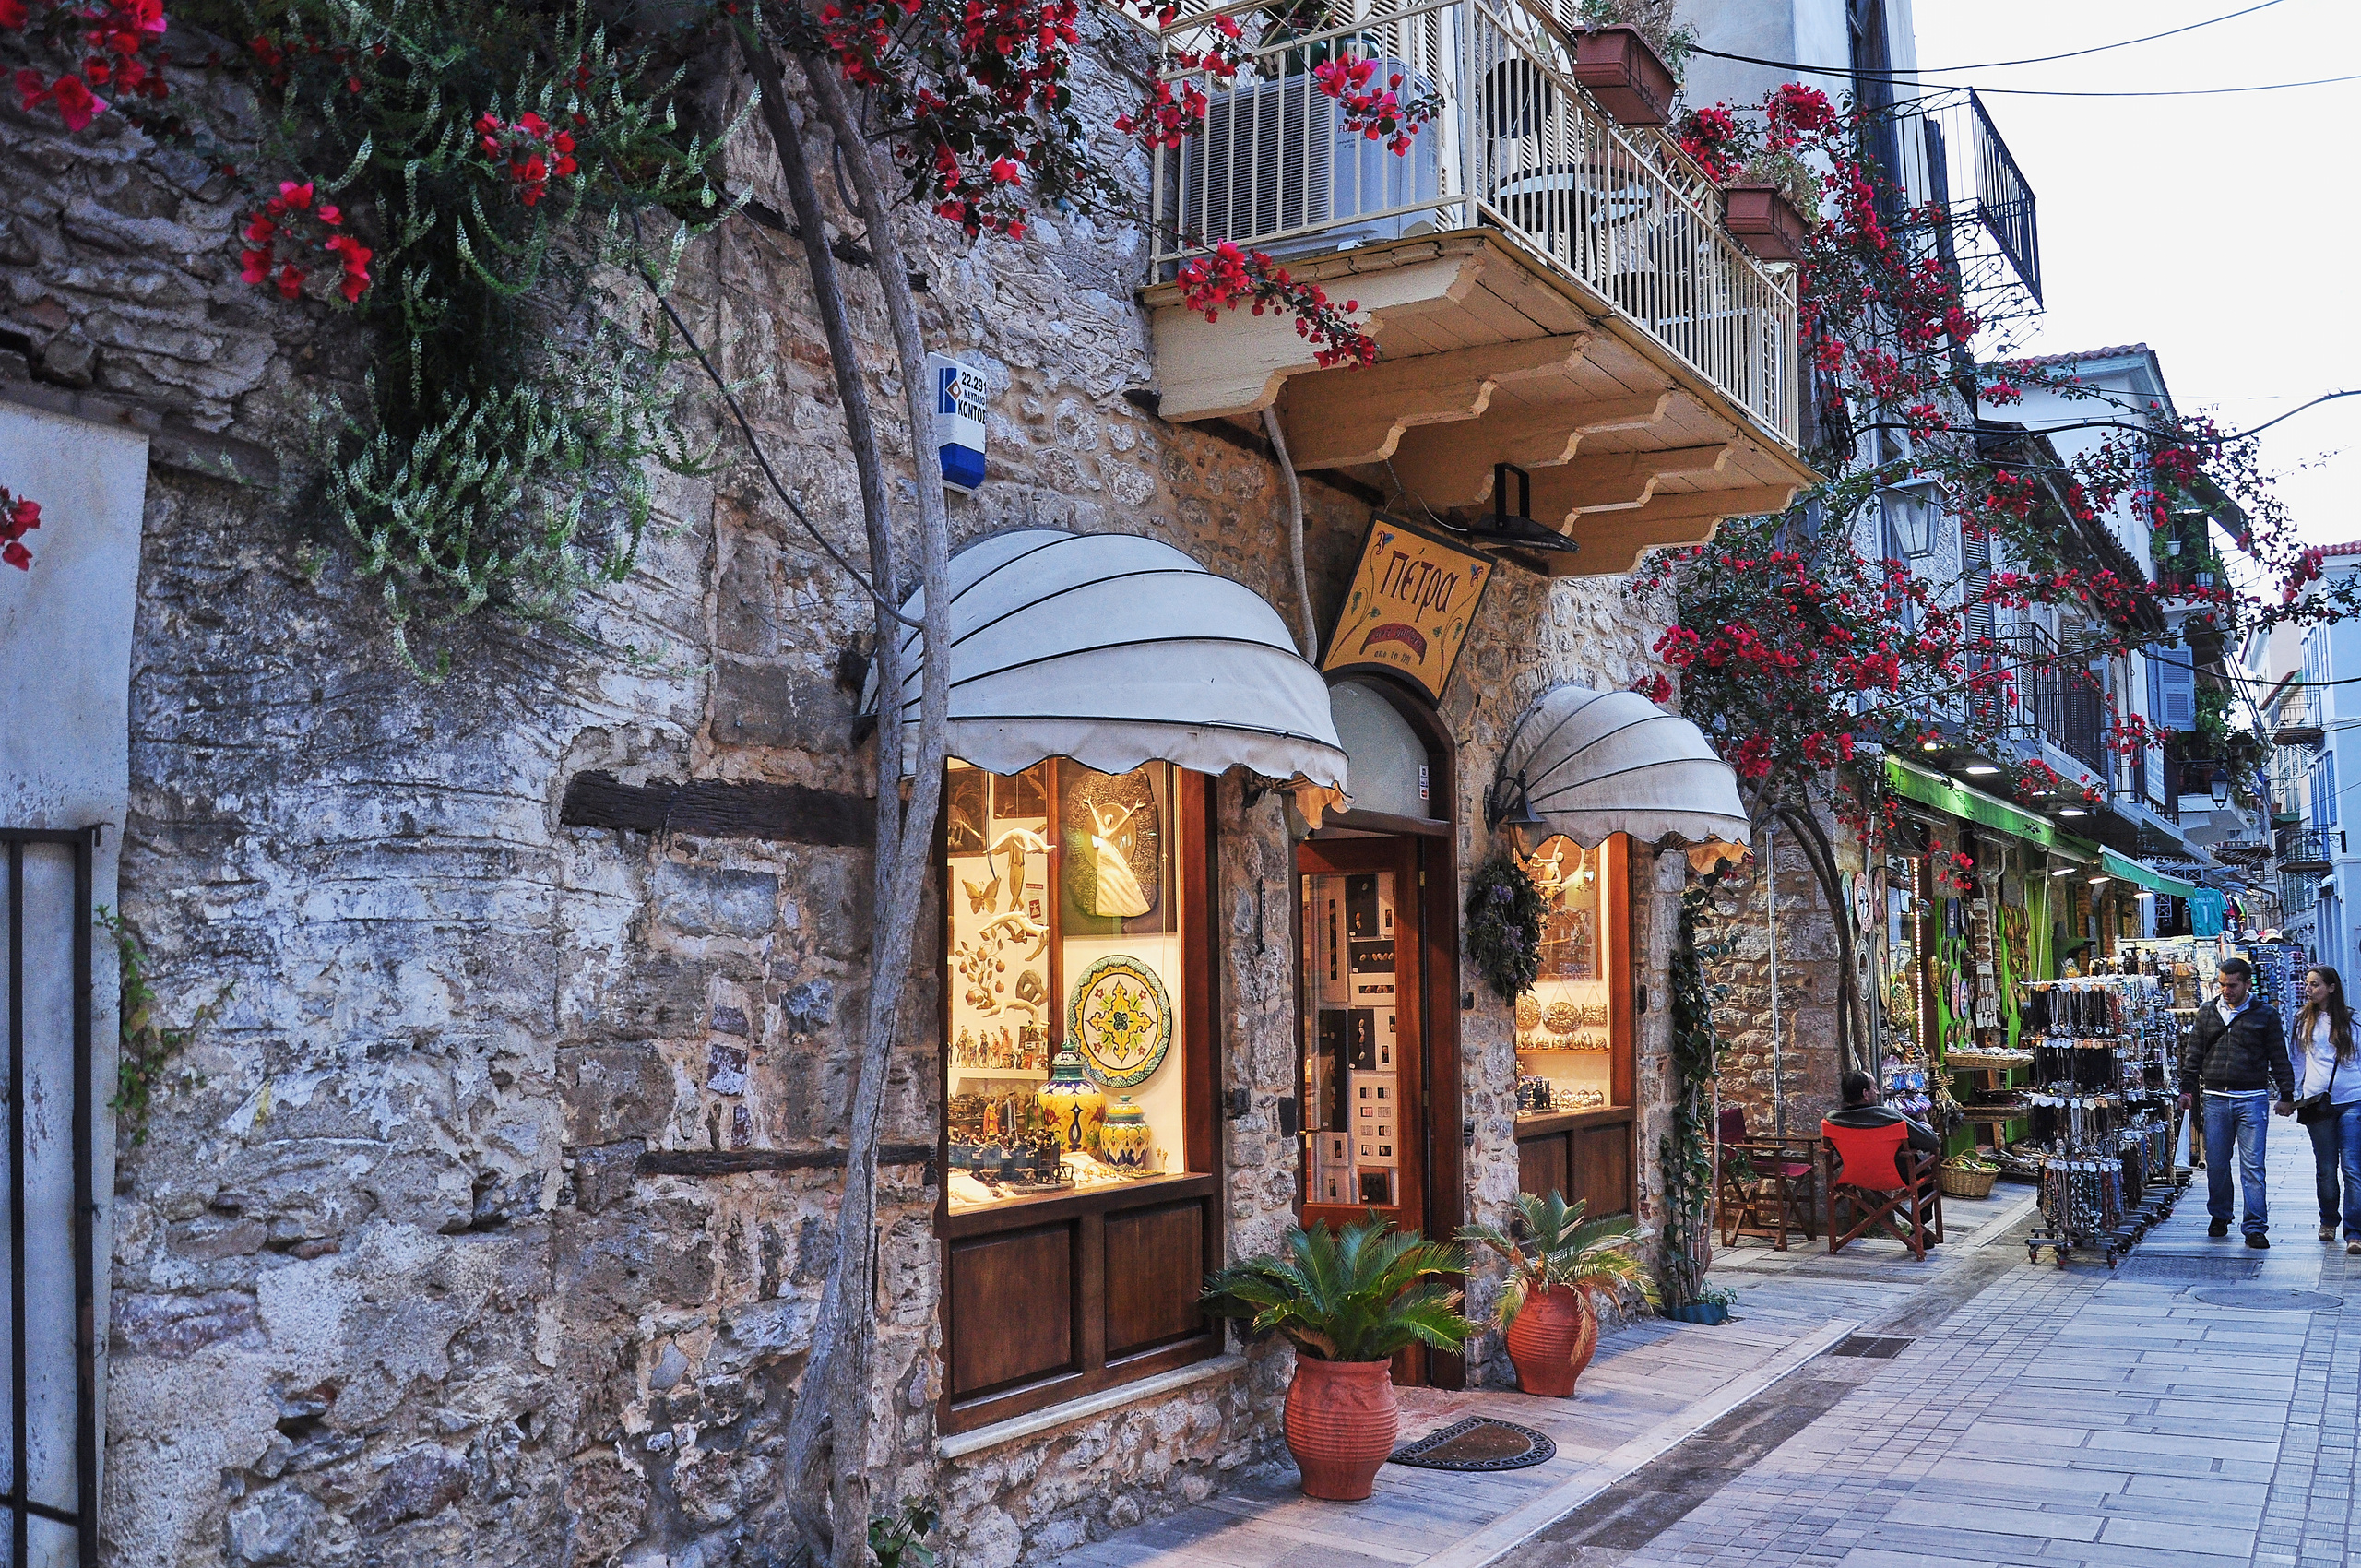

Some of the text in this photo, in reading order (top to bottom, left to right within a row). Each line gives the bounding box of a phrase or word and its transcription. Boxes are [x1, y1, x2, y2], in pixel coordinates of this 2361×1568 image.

[958, 398, 986, 424] ΚΟΝΤΟΣ
[1380, 548, 1460, 623] Πέτρα
[2202, 905, 2209, 924] 1
